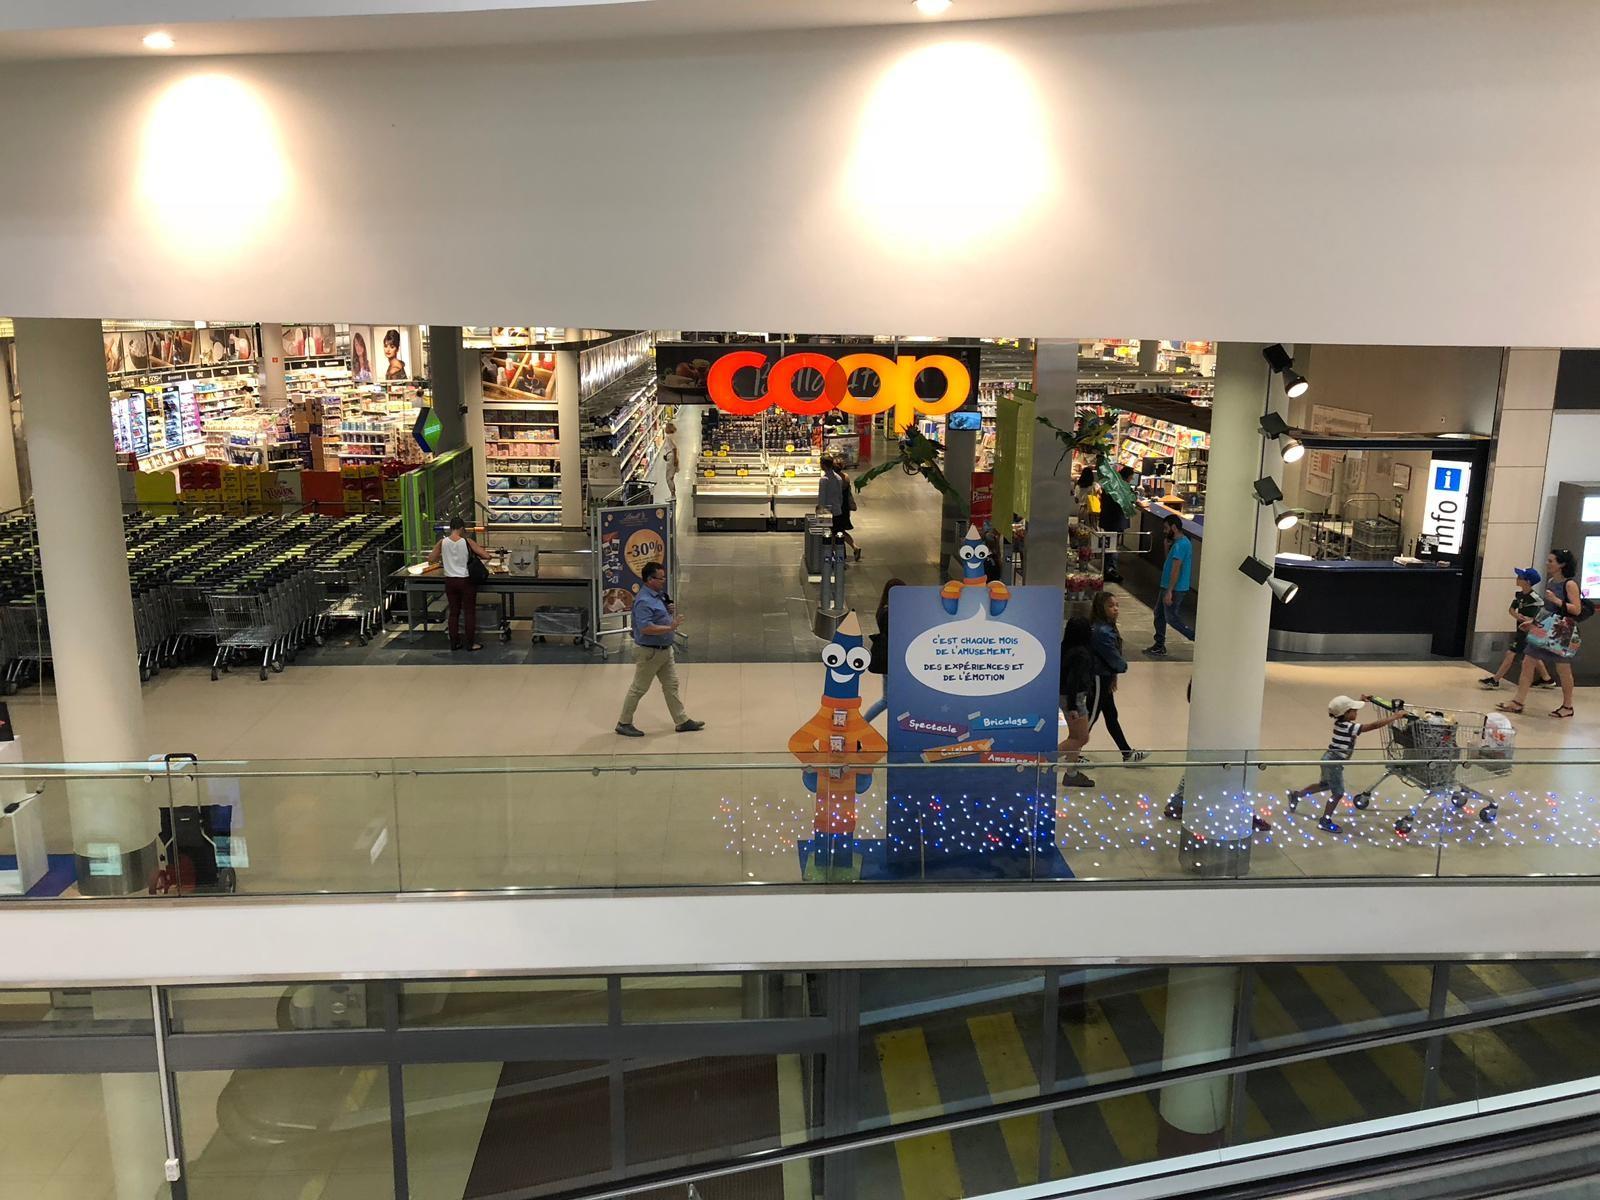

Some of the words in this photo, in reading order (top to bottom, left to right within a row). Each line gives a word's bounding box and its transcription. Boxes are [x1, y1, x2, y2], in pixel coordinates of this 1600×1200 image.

[707, 350, 971, 433] coop
[1431, 500, 1458, 546] info
[627, 540, 663, 557] -30%
[932, 634, 958, 645] C'EST
[960, 637, 996, 645] CHAQUE
[999, 636, 1019, 645] MOIS
[936, 648, 949, 656] DE
[923, 663, 942, 671] DES
[944, 661, 1010, 671] EXPÉRIENCES
[1011, 663, 1025, 671] ET
[958, 671, 1005, 681] L'ÉMOTION
[909, 719, 957, 734] Spectacle
[983, 716, 1029, 727] Bricolage
[941, 745, 974, 756] Cuisine
